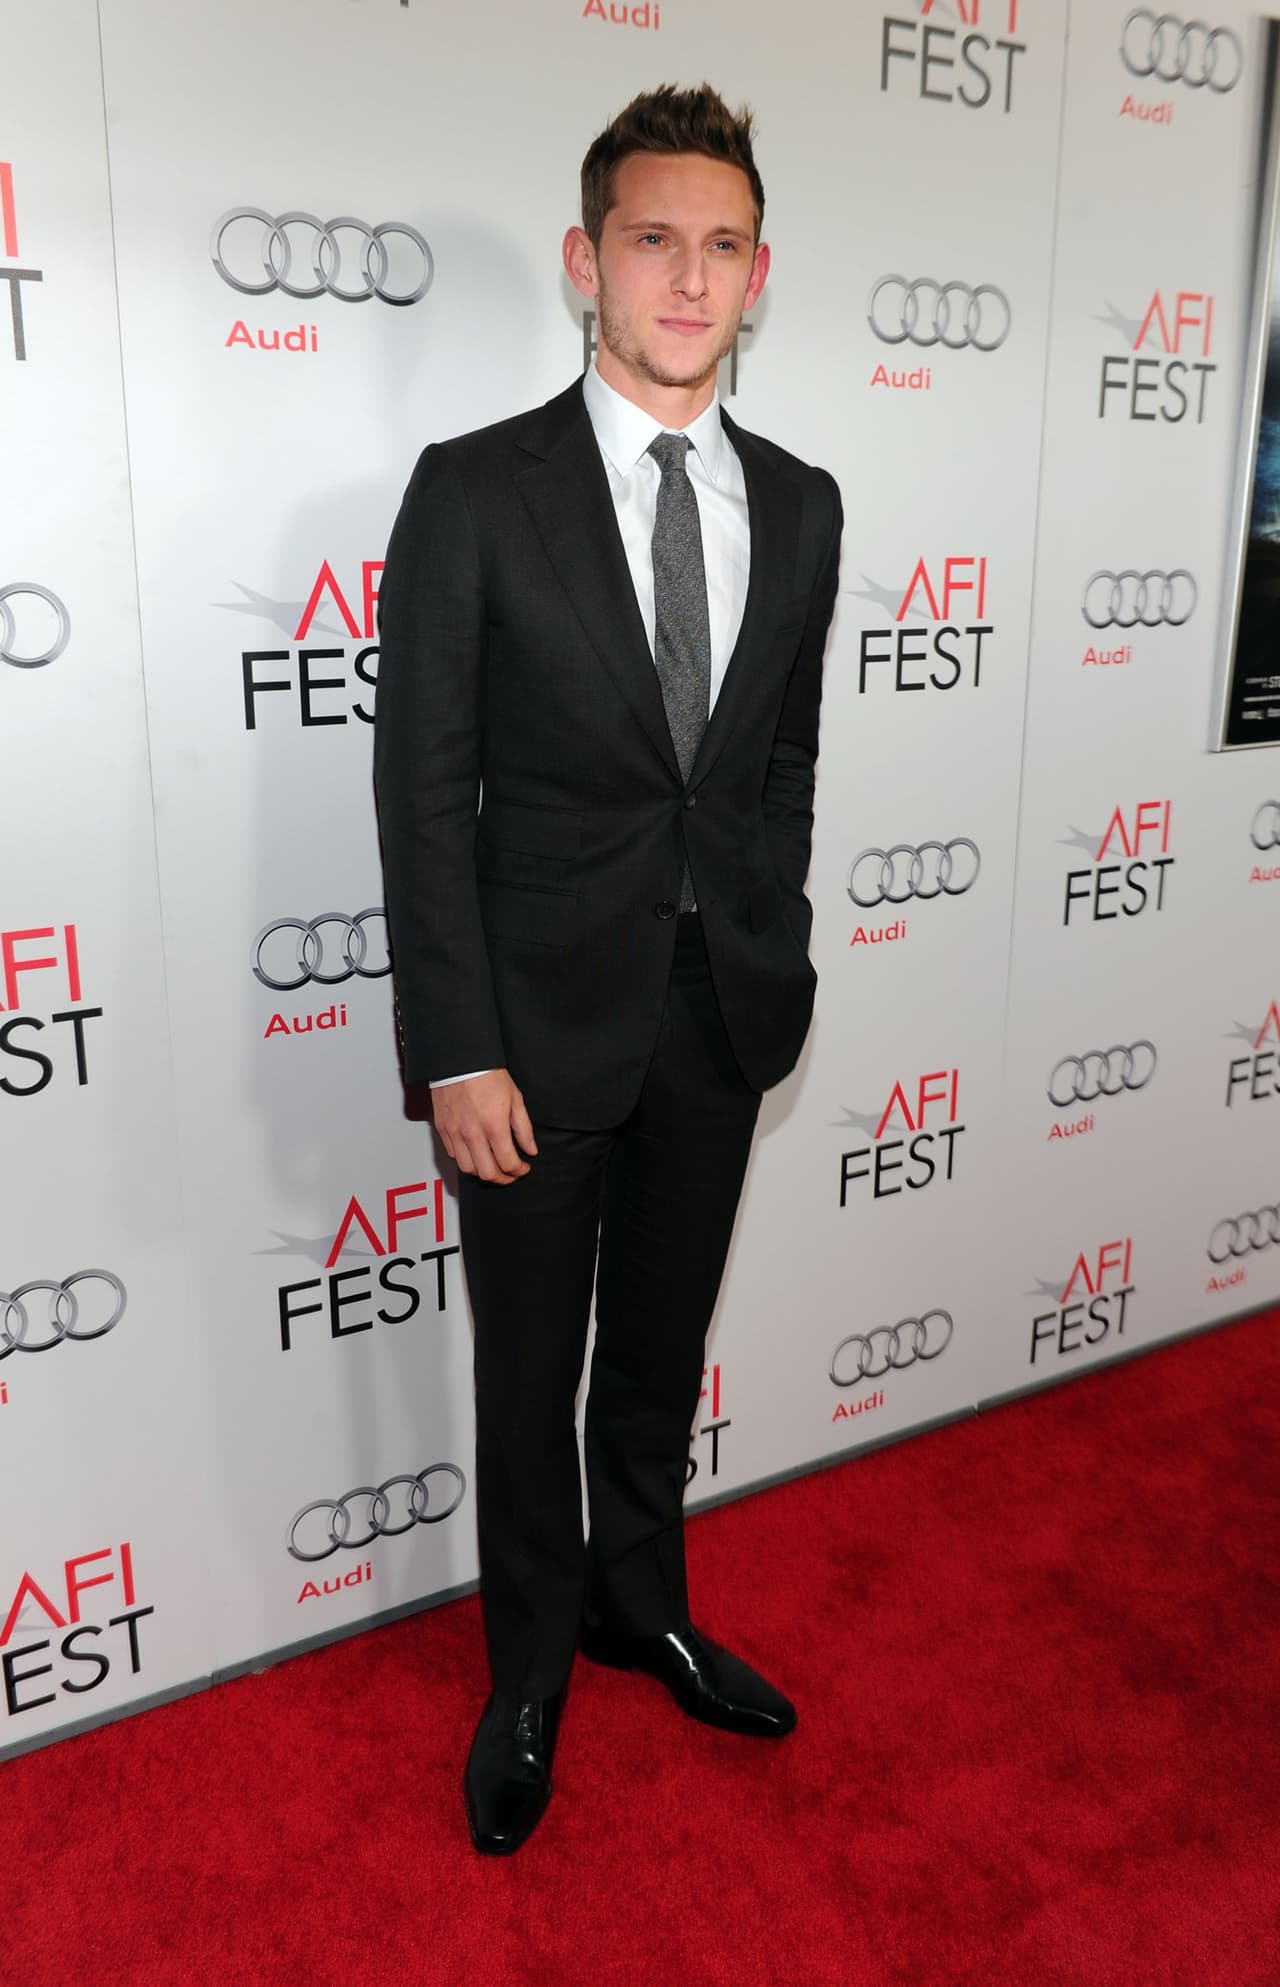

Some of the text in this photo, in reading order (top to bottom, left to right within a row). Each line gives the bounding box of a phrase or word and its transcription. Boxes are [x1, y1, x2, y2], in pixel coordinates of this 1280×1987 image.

[583, 0, 660, 30] Audi
[881, 16, 1026, 113] FEST
[1119, 96, 1173, 124] Audi
[225, 320, 319, 352] Audi
[1133, 290, 1215, 356] AFI
[870, 363, 931, 390] Audi
[1098, 355, 1217, 423] FEST
[294, 560, 386, 640] AF
[896, 557, 987, 621] AFI
[242, 646, 380, 730] FES
[859, 627, 993, 693] FEST
[1081, 646, 1132, 666] Audi
[1096, 800, 1171, 861] AFI
[1064, 858, 1175, 925] FEST
[850, 920, 907, 946] Audi
[264, 1004, 347, 1039] Audi
[875, 1069, 958, 1139] AFI
[1048, 1116, 1095, 1140] Audi
[840, 1126, 965, 1207] FEST
[325, 1178, 445, 1268] AFI
[279, 1245, 459, 1351] FEST
[1061, 1238, 1132, 1304] AFI
[1206, 1269, 1245, 1293] Audi
[1030, 1286, 1135, 1364] FEST
[832, 1390, 884, 1421] Audi
[0, 1543, 135, 1647] AFI
[297, 1561, 373, 1604] Audi
[2, 1606, 154, 1716] EST
